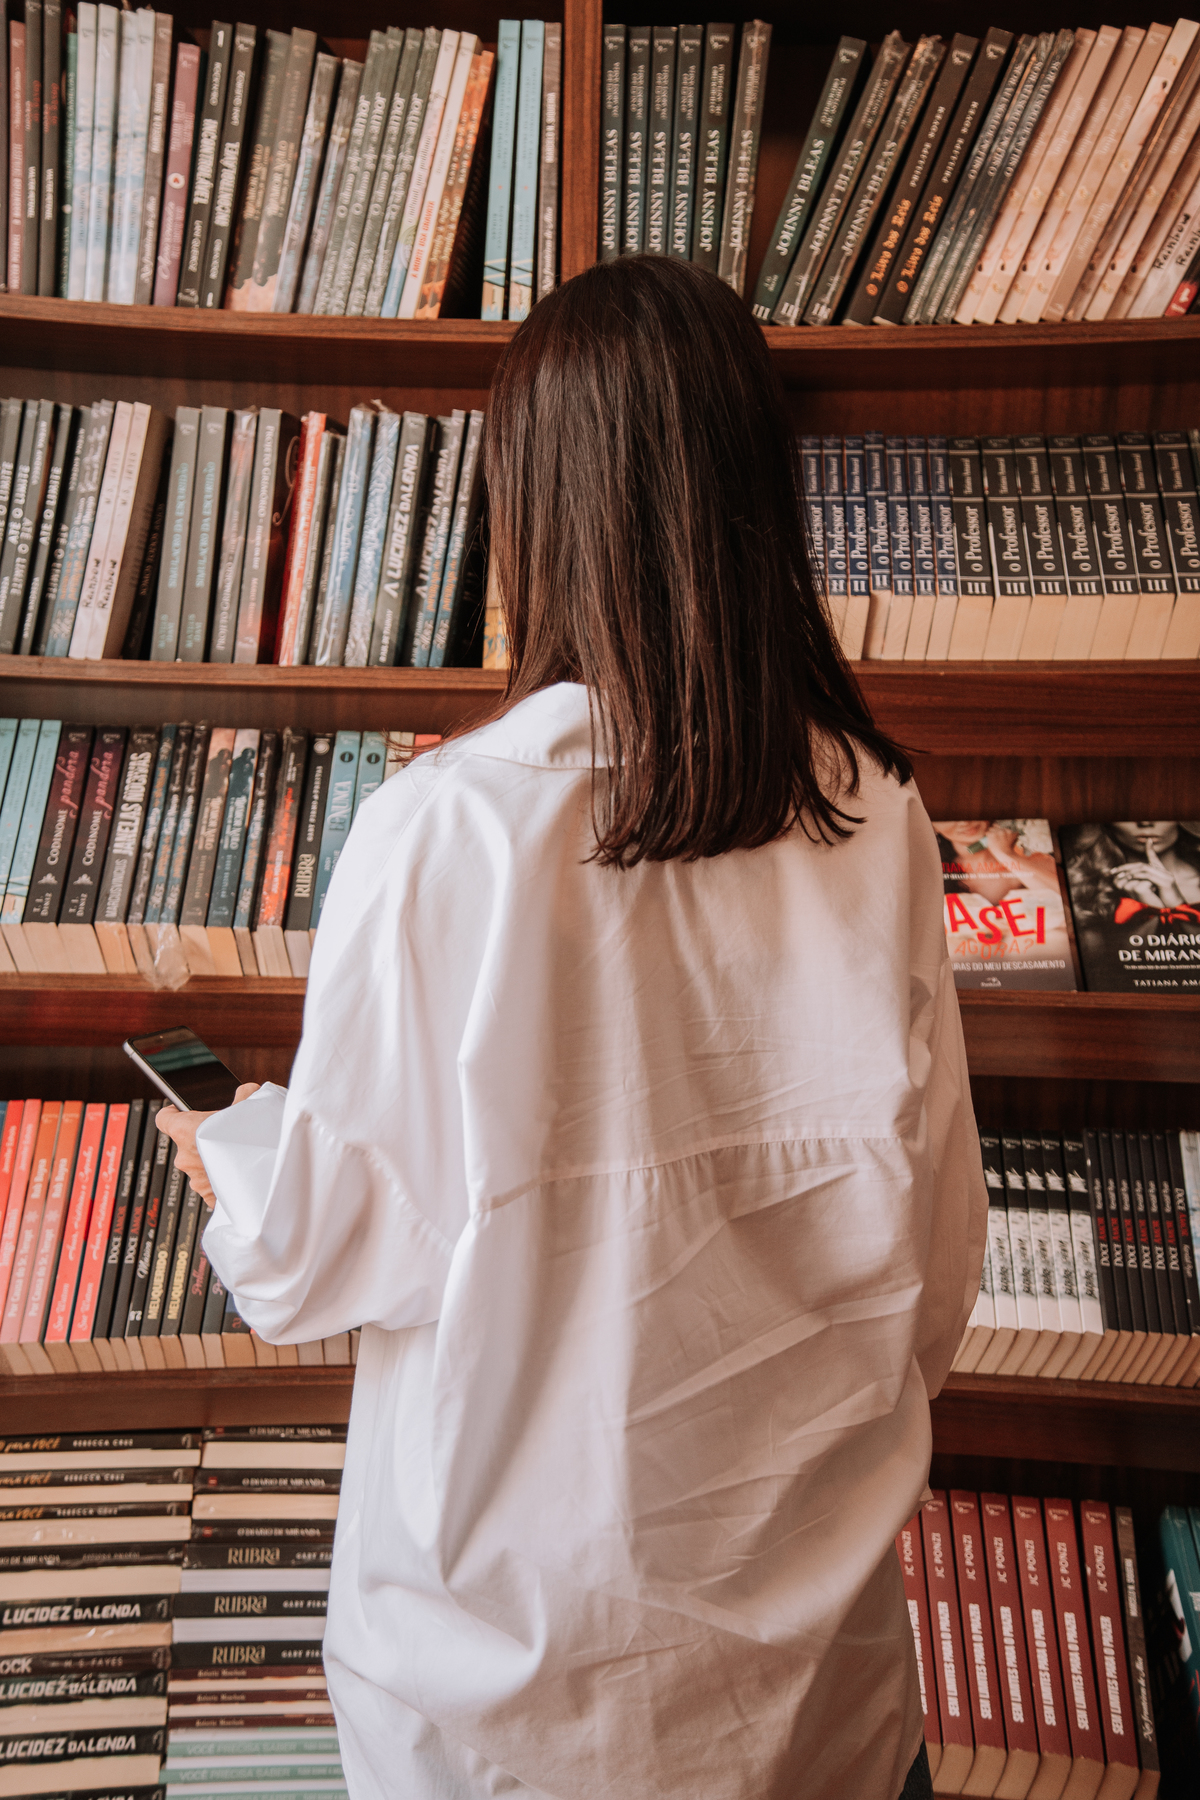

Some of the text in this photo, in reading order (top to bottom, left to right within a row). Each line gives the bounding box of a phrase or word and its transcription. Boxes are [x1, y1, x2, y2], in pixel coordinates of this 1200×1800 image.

[352, 95, 370, 137] amor
[369, 92, 386, 135] amor
[387, 92, 405, 135] amor
[193, 119, 218, 205] INCONTROLÁVEL
[604, 130, 618, 183] BLEAS
[628, 132, 642, 185] BLEAS
[651, 131, 666, 185] BLEAS
[676, 132, 691, 186] BLEAS
[704, 130, 720, 184] BLEAS
[215, 142, 240, 227] INCONTROLÁVEL
[730, 130, 753, 251] JOHNNY BLEAS
[776, 139, 824, 256] JOHNNY BLEAS
[809, 197, 841, 253] JOHNNY
[834, 140, 863, 192] BLEAS
[841, 140, 897, 256] JOHNNY BLEAS
[602, 188, 616, 250] JOHNNY
[625, 189, 640, 252] JOHNNY
[649, 189, 663, 252] JOHNNY
[673, 190, 688, 253] JOHNNY
[700, 189, 716, 252] JOHNNY
[15, 465, 30, 504] LIMITE
[46, 466, 62, 506] LIMITE
[402, 444, 419, 493] LENDA
[386, 511, 408, 579] LUCIDEZ
[828, 505, 847, 570] o Professor
[850, 505, 868, 571] o Professor
[870, 499, 890, 565] o Professor
[891, 505, 910, 559] Professor
[913, 504, 932, 559] Professor
[935, 504, 955, 559] Professor
[961, 506, 983, 561] Professor
[999, 505, 1020, 560] Professor
[1032, 505, 1054, 560] Professor
[1067, 505, 1090, 560] Professor
[1102, 503, 1125, 559] Professor
[1138, 502, 1160, 557] Professor
[1175, 501, 1199, 556] Professor
[383, 583, 399, 598] A
[967, 582, 987, 594] III
[1006, 582, 1025, 594] III
[1041, 581, 1060, 594] III
[1076, 581, 1097, 594] III
[123, 752, 151, 802] NOCIVAS
[47, 809, 68, 865] CODINOME
[83, 810, 103, 865] CODINOME
[113, 803, 142, 856] JANELAS
[972, 960, 1066, 971] DO MEU DESCASAMENTO
[1118, 950, 1142, 961] DE
[1129, 935, 1143, 946] O
[108, 1206, 126, 1264] DOCE AMOR
[125, 1206, 143, 1264] DOCE AMOR
[902, 1531, 915, 1576] JC PONZI
[932, 1532, 945, 1578] JC PONZI
[962, 1534, 976, 1580] JC PONZI
[994, 1537, 1008, 1584] JC PONZI
[1025, 1539, 1039, 1586] JC PONZI
[1057, 1542, 1070, 1574] PONZI
[1094, 1545, 1106, 1578] PONZI
[2, 1603, 141, 1625] LUCIDEZ LENDA
[0, 1677, 137, 1700] LUCIDEZ LENDA
[87, 1735, 136, 1752] LENDA
